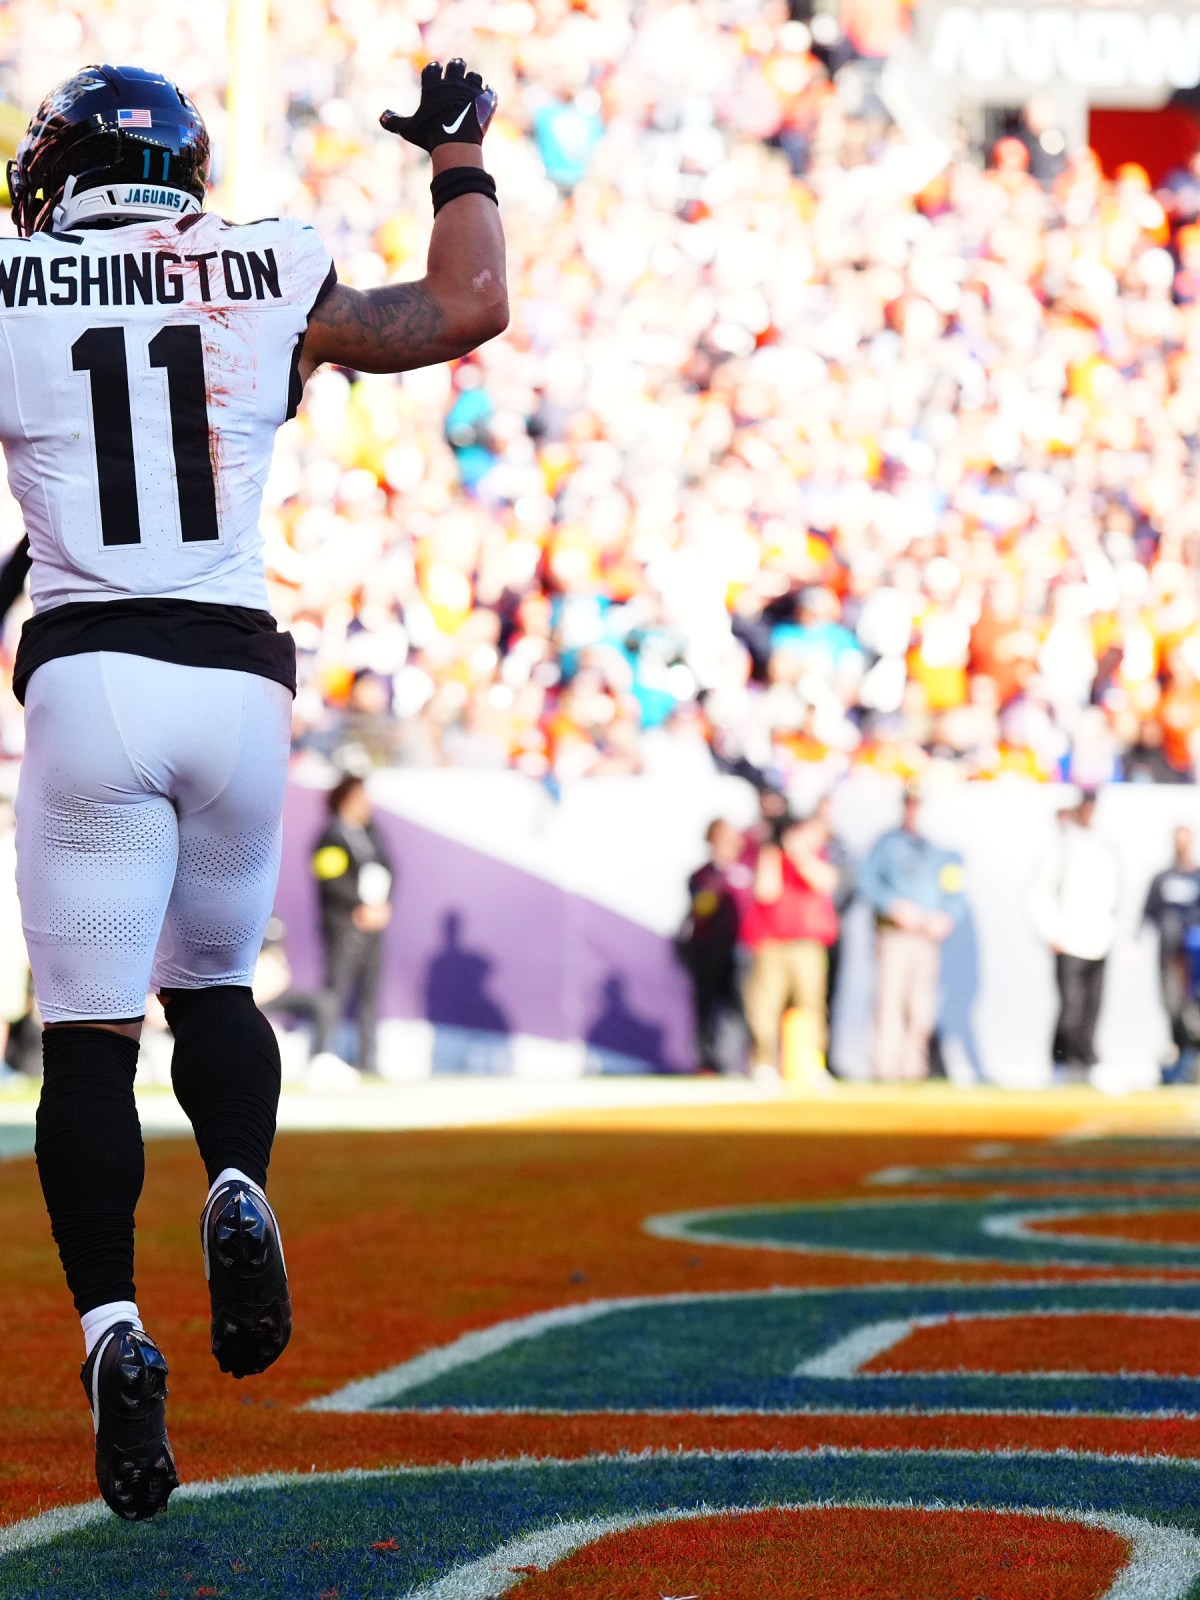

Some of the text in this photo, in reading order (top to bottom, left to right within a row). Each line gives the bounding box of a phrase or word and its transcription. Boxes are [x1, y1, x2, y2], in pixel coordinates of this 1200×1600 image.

[142, 148, 170, 181] 11
[124, 189, 181, 208] JAGUARS
[71, 324, 220, 546] 11
